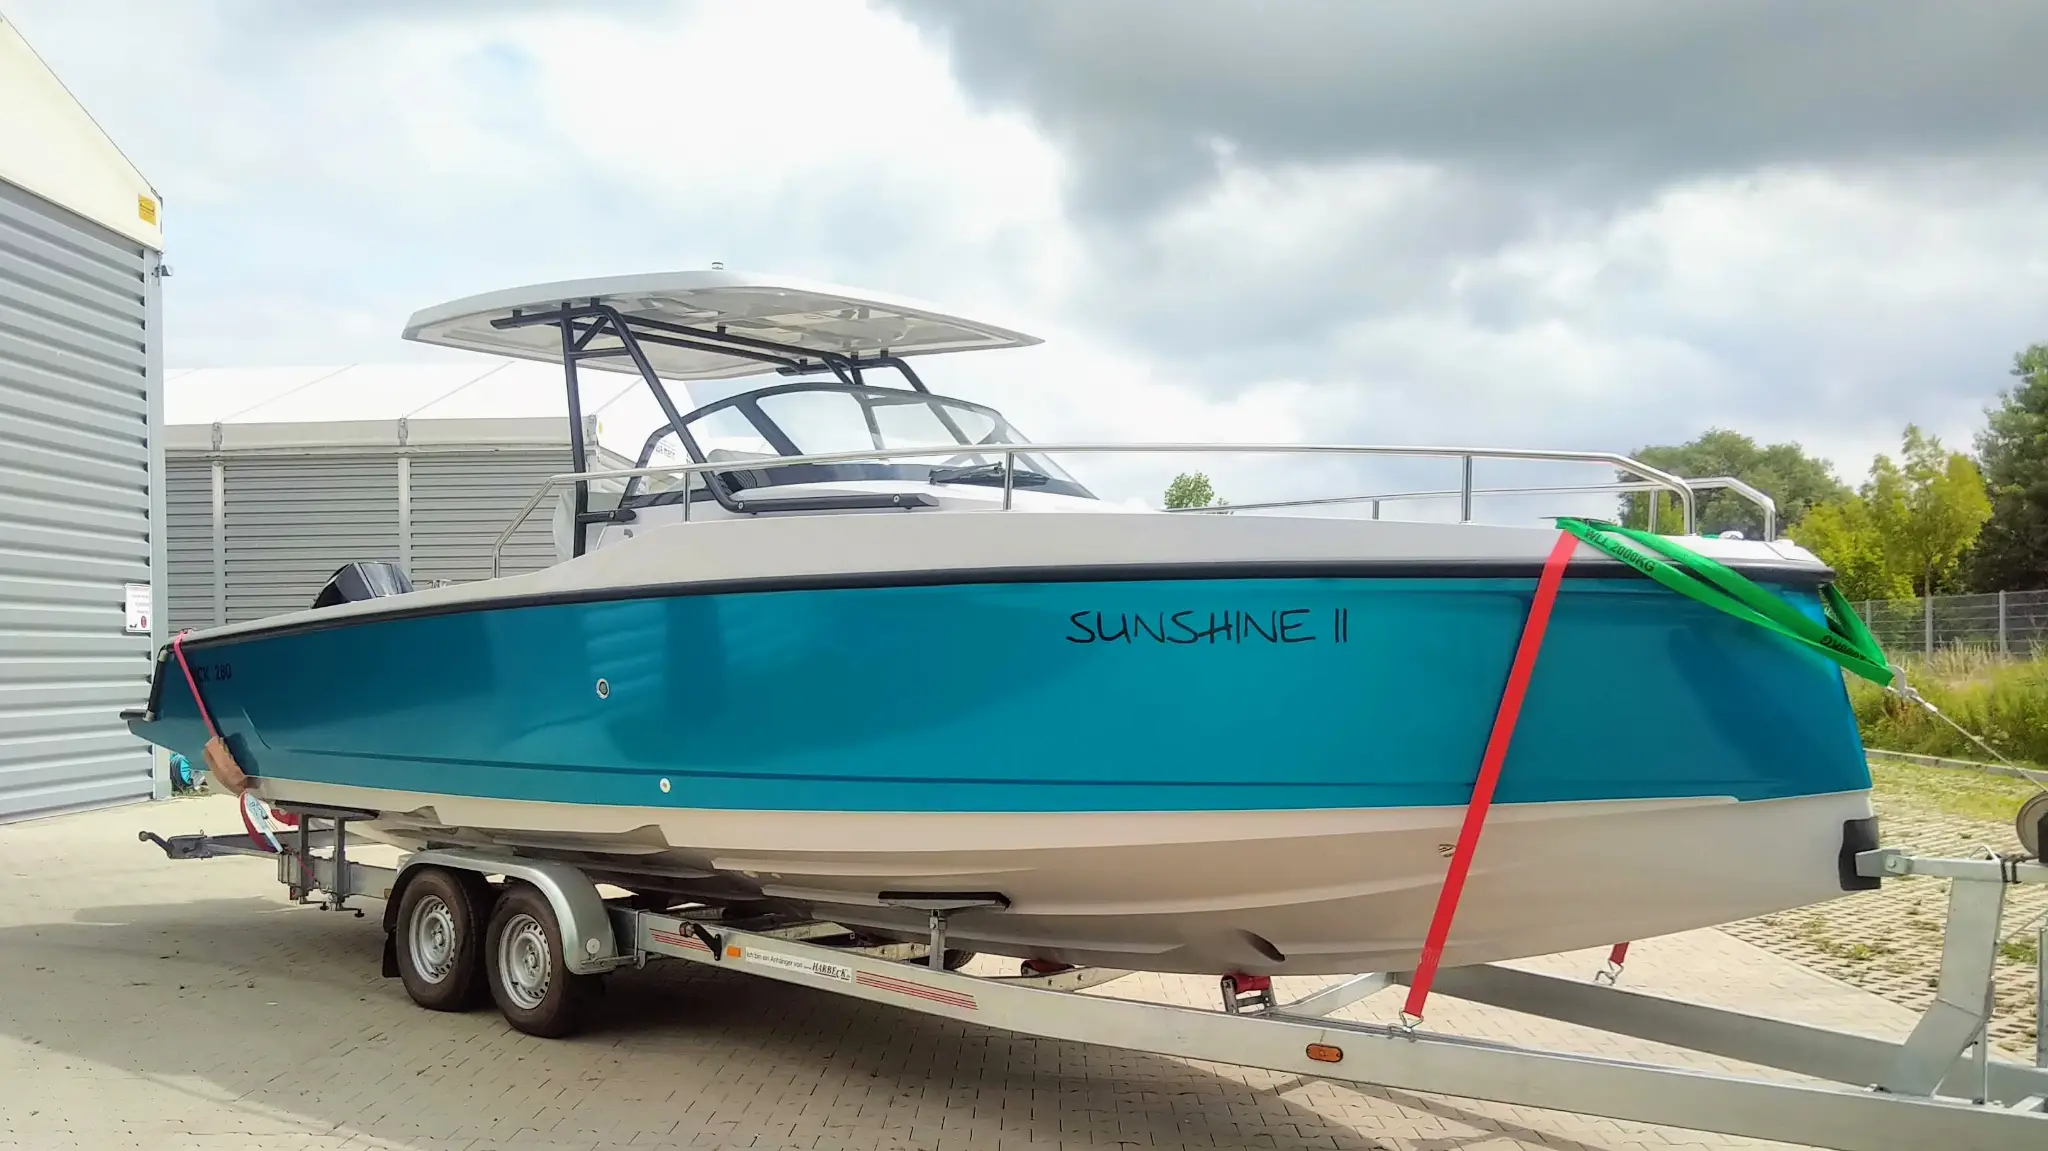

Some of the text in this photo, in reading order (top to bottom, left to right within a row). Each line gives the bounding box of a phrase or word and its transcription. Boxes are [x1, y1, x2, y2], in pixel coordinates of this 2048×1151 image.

[1611, 543, 1655, 573] 2000KG
[1066, 608, 1317, 645] SUNSHINE
[214, 662, 232, 681] 280
[793, 961, 803, 969] von
[812, 961, 850, 980] HARBECK
